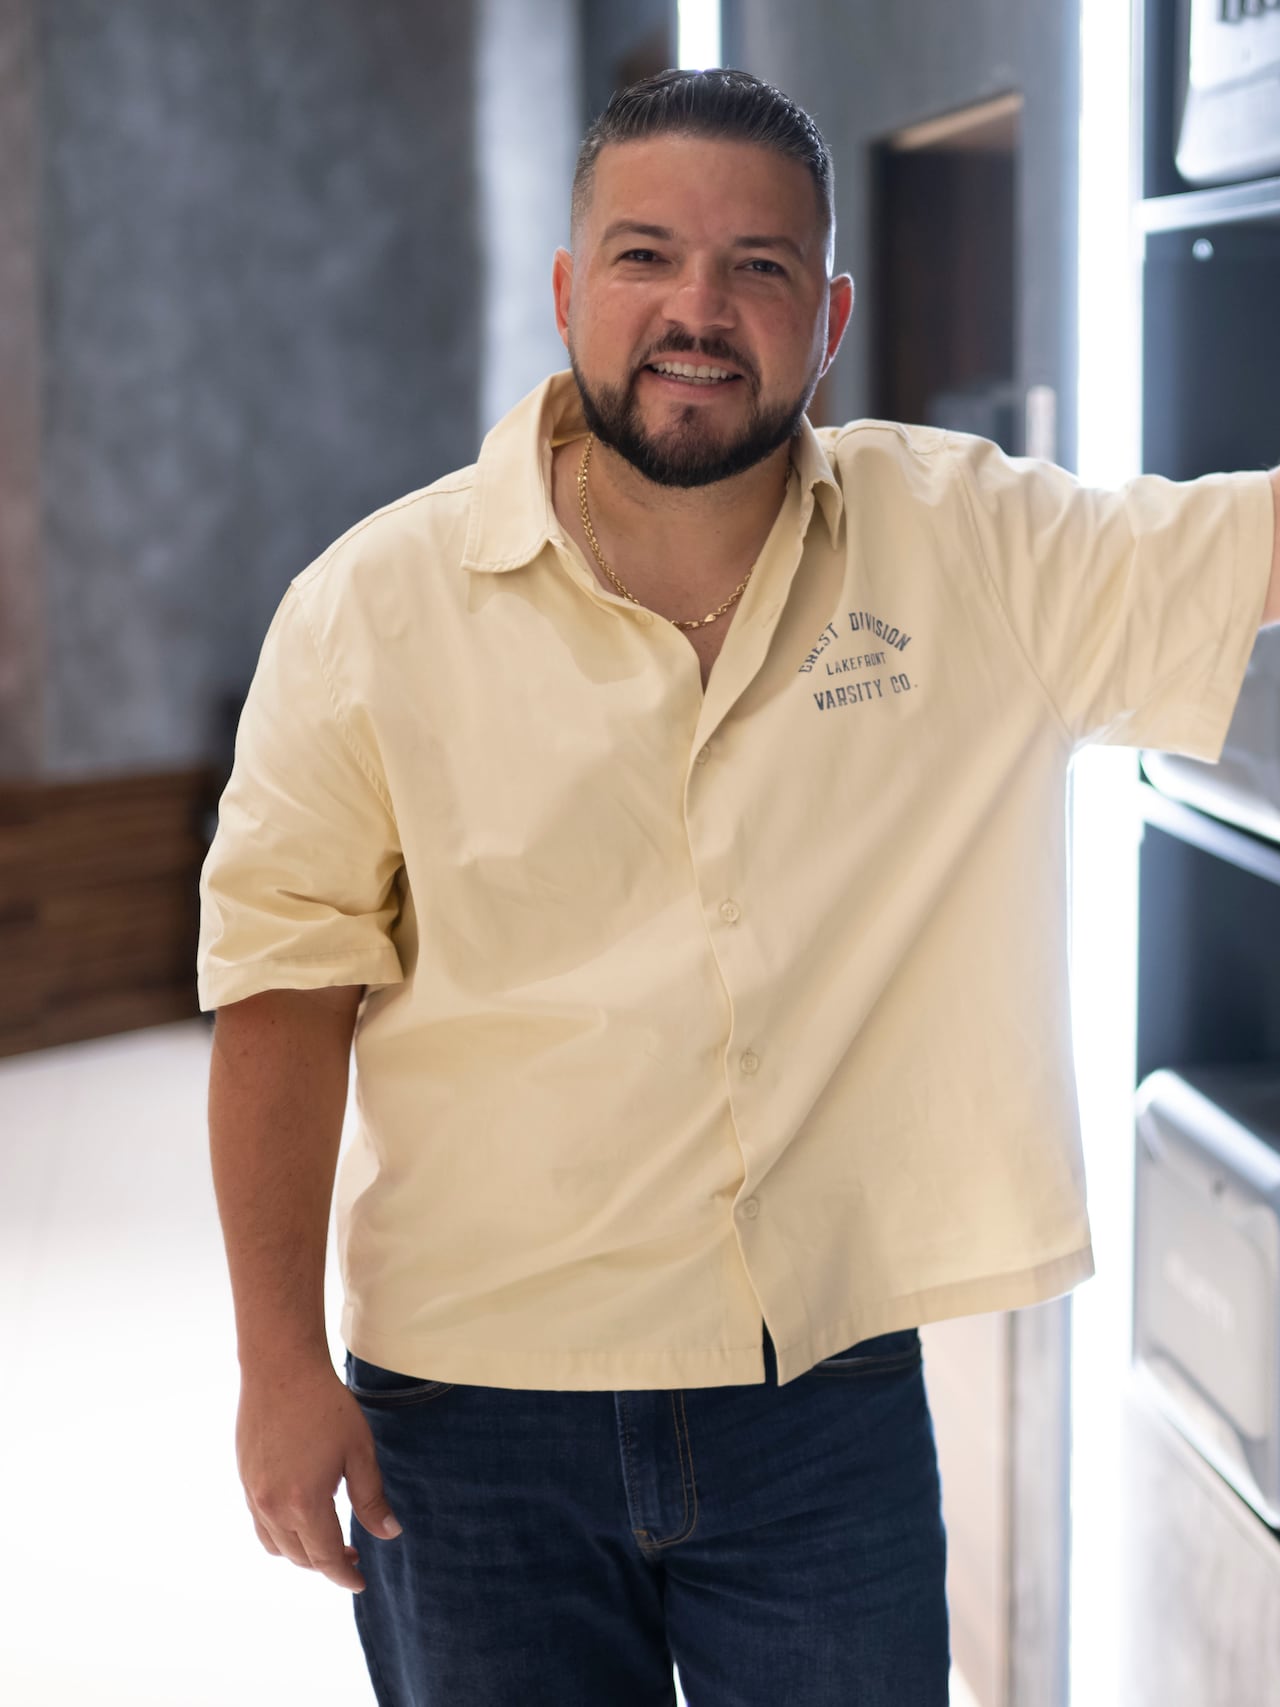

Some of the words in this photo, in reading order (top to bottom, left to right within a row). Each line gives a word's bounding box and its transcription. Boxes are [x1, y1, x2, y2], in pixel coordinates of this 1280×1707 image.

[849, 611, 912, 652] DIVISION
[826, 651, 886, 676] LAKEFRONT
[813, 678, 883, 711] VARSITY
[890, 672, 918, 694] CO.
